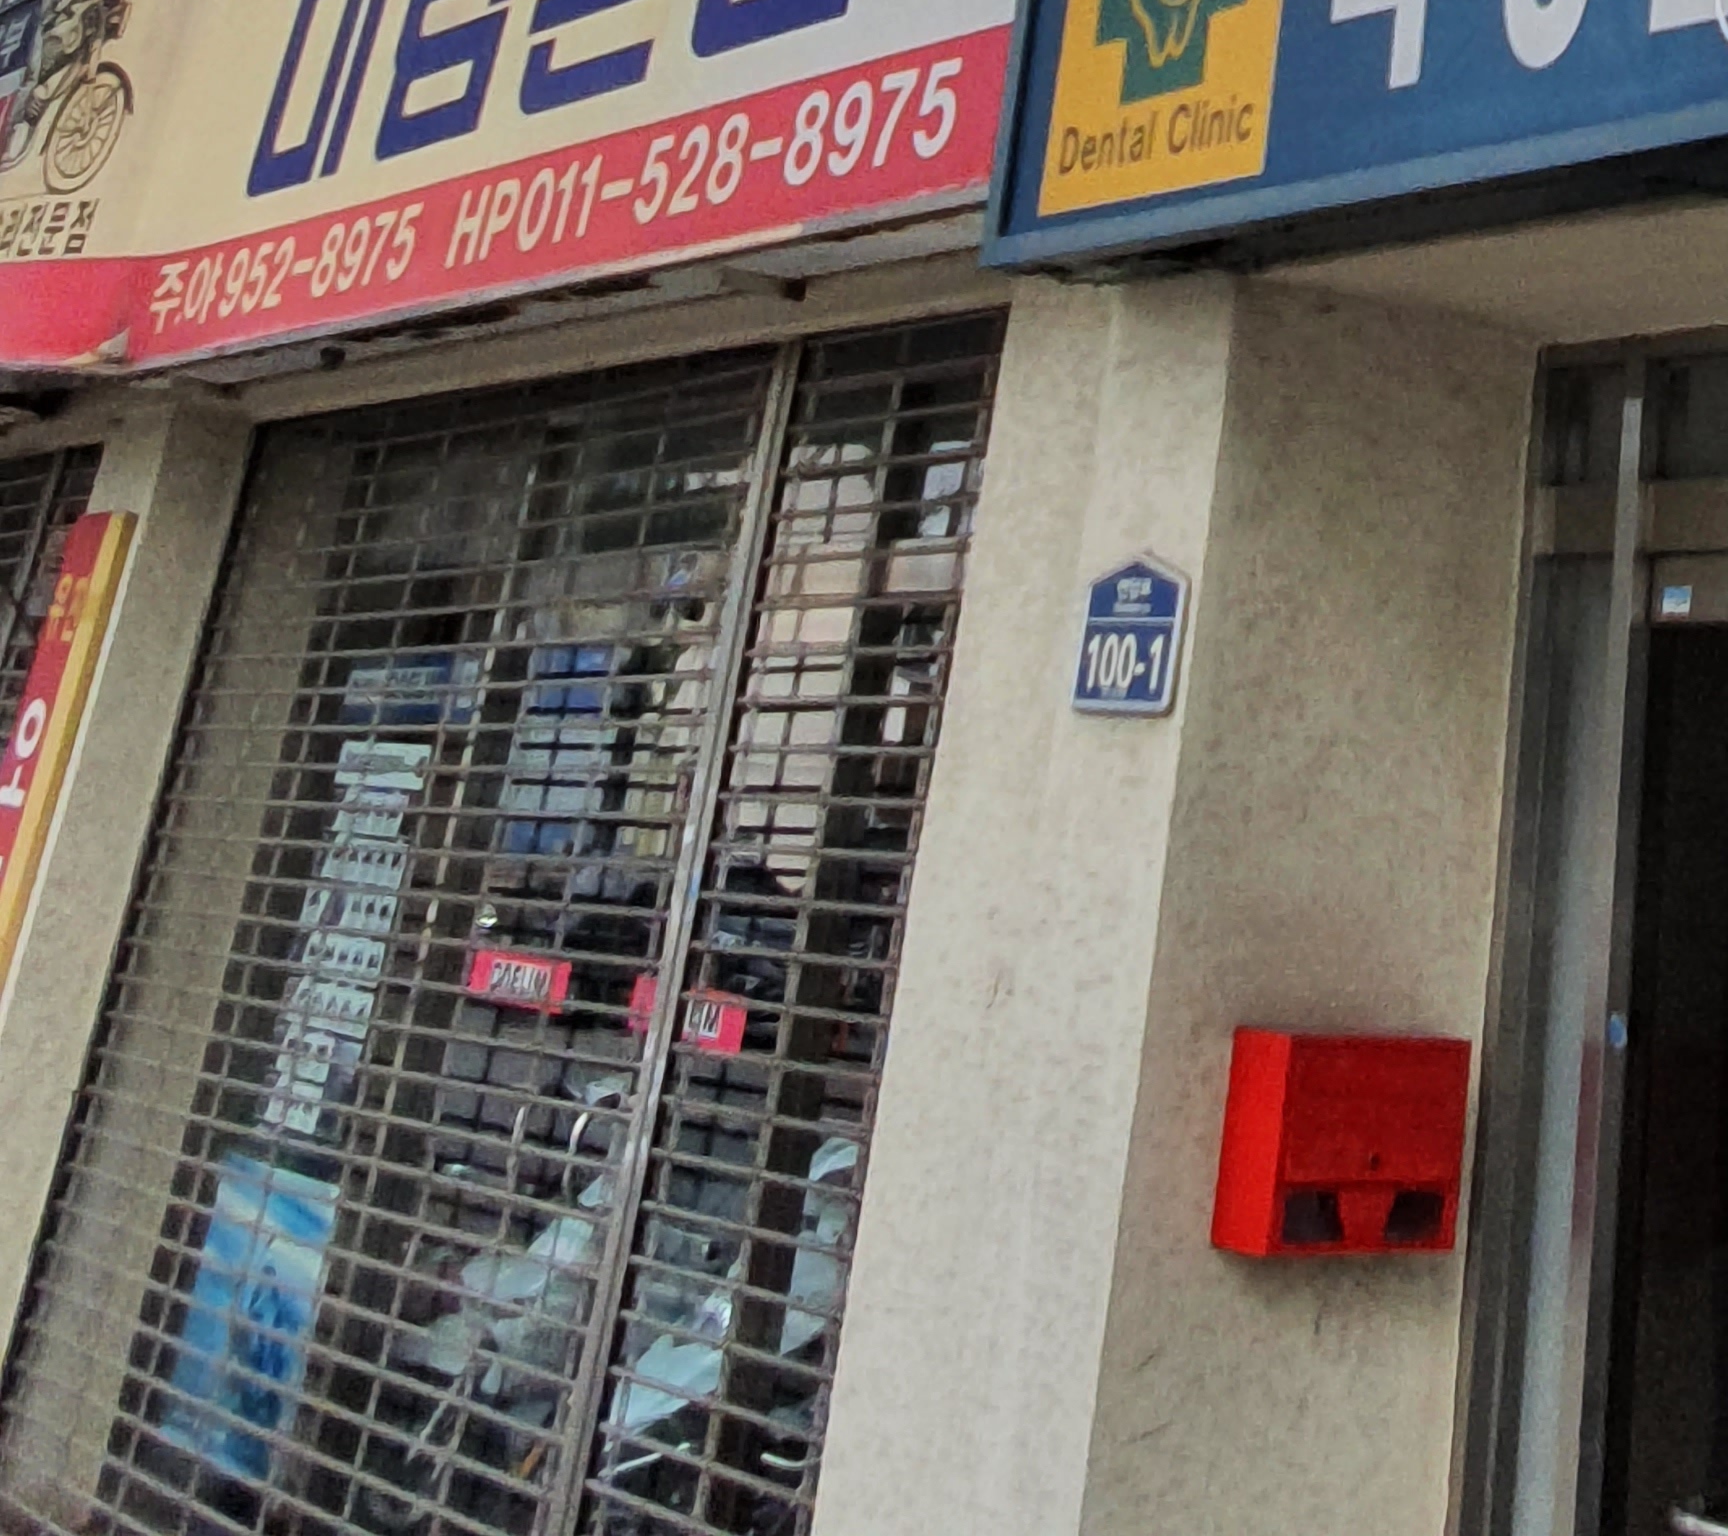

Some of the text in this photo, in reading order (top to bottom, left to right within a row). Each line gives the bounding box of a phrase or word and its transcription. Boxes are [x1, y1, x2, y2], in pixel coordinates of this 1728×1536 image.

[1057, 93, 1256, 176] Dental Clinic
[0, 198, 100, 258] 리전문점
[1086, 633, 1165, 694] 100-1
